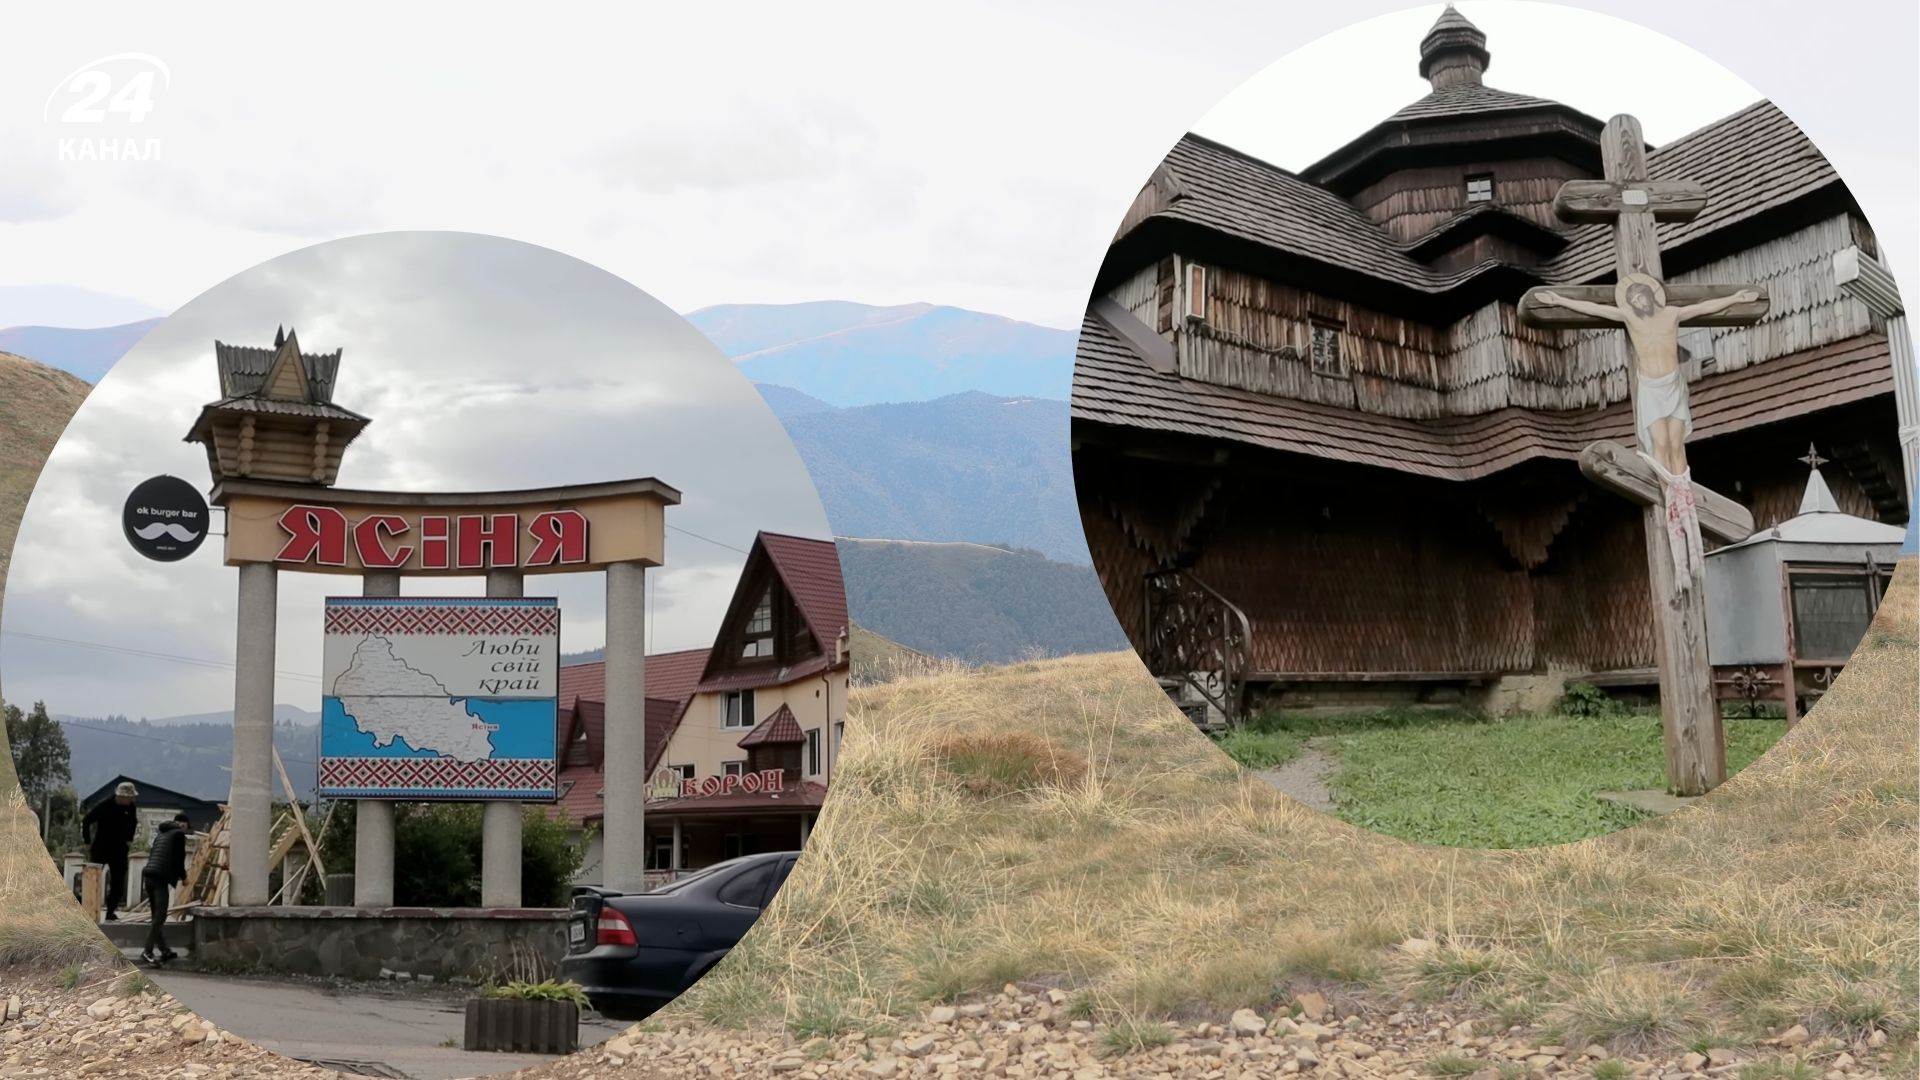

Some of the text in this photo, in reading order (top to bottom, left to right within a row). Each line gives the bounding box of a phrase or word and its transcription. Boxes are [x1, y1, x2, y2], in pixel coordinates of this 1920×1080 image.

[136, 507, 198, 518] ok burger bar
[461, 638, 540, 657] Люби
[491, 657, 540, 673] свій
[479, 676, 540, 695] край
